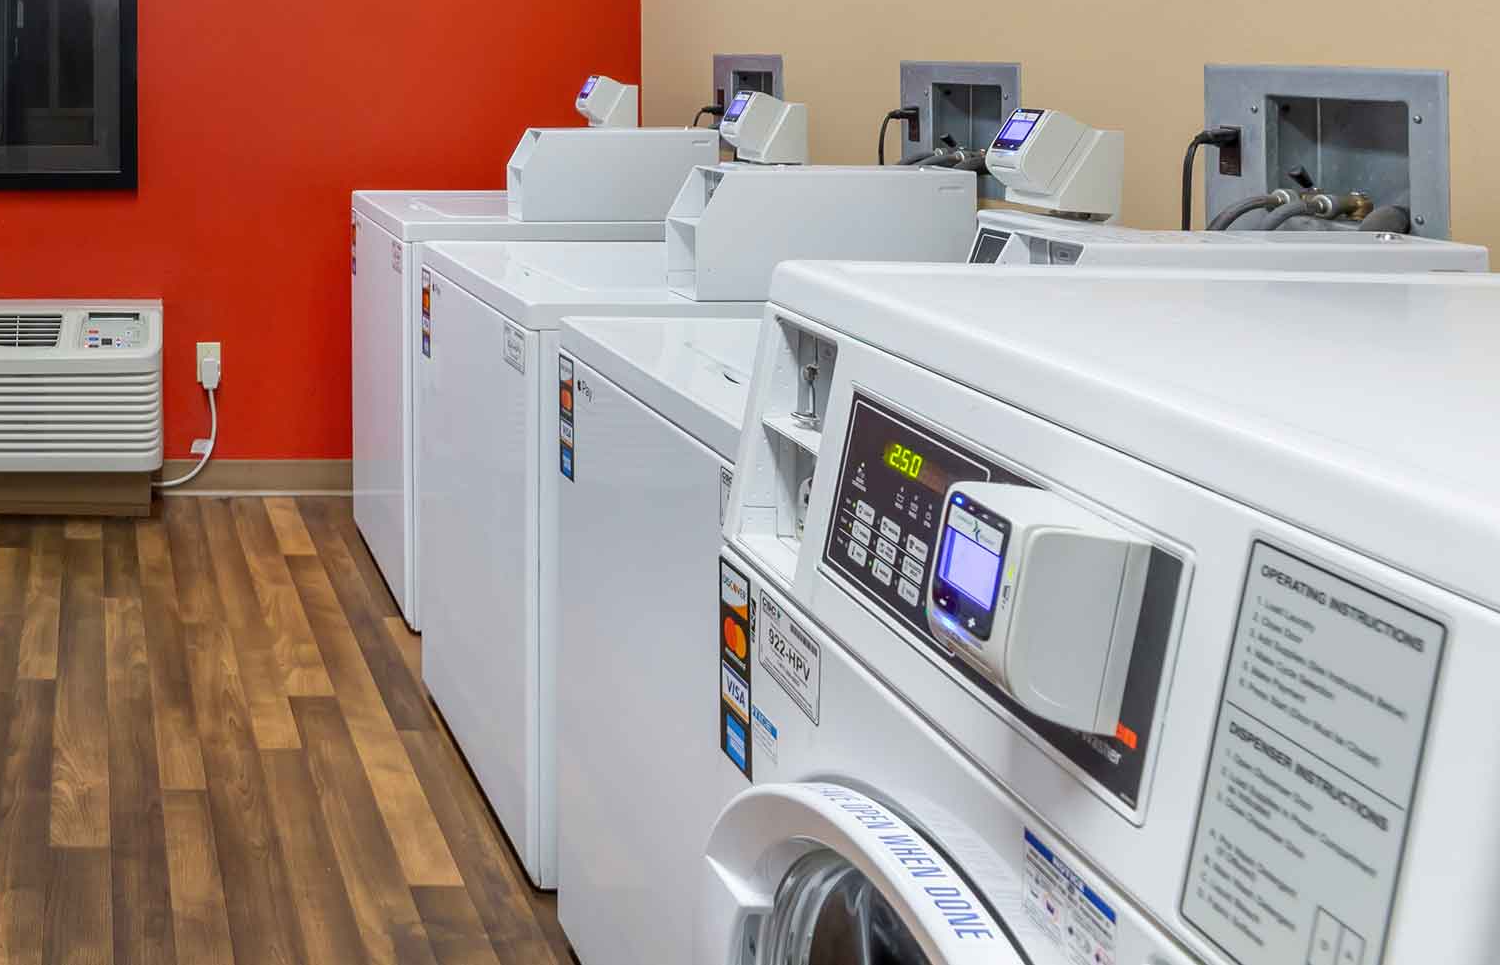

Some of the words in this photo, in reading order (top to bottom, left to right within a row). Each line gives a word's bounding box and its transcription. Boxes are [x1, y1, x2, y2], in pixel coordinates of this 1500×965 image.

[889, 443, 923, 478] 2.50
[1260, 564, 1327, 606] OPERATING
[1329, 596, 1426, 654] INSTRUCTIONS
[768, 627, 810, 682] 922-HPV
[726, 675, 746, 709] VISA
[1228, 720, 1293, 770] DISPENSER
[1294, 762, 1389, 832] INSTRUCTIONS
[841, 803, 901, 829] OPEN
[877, 834, 949, 878] WHEN
[923, 886, 995, 940] DONE
